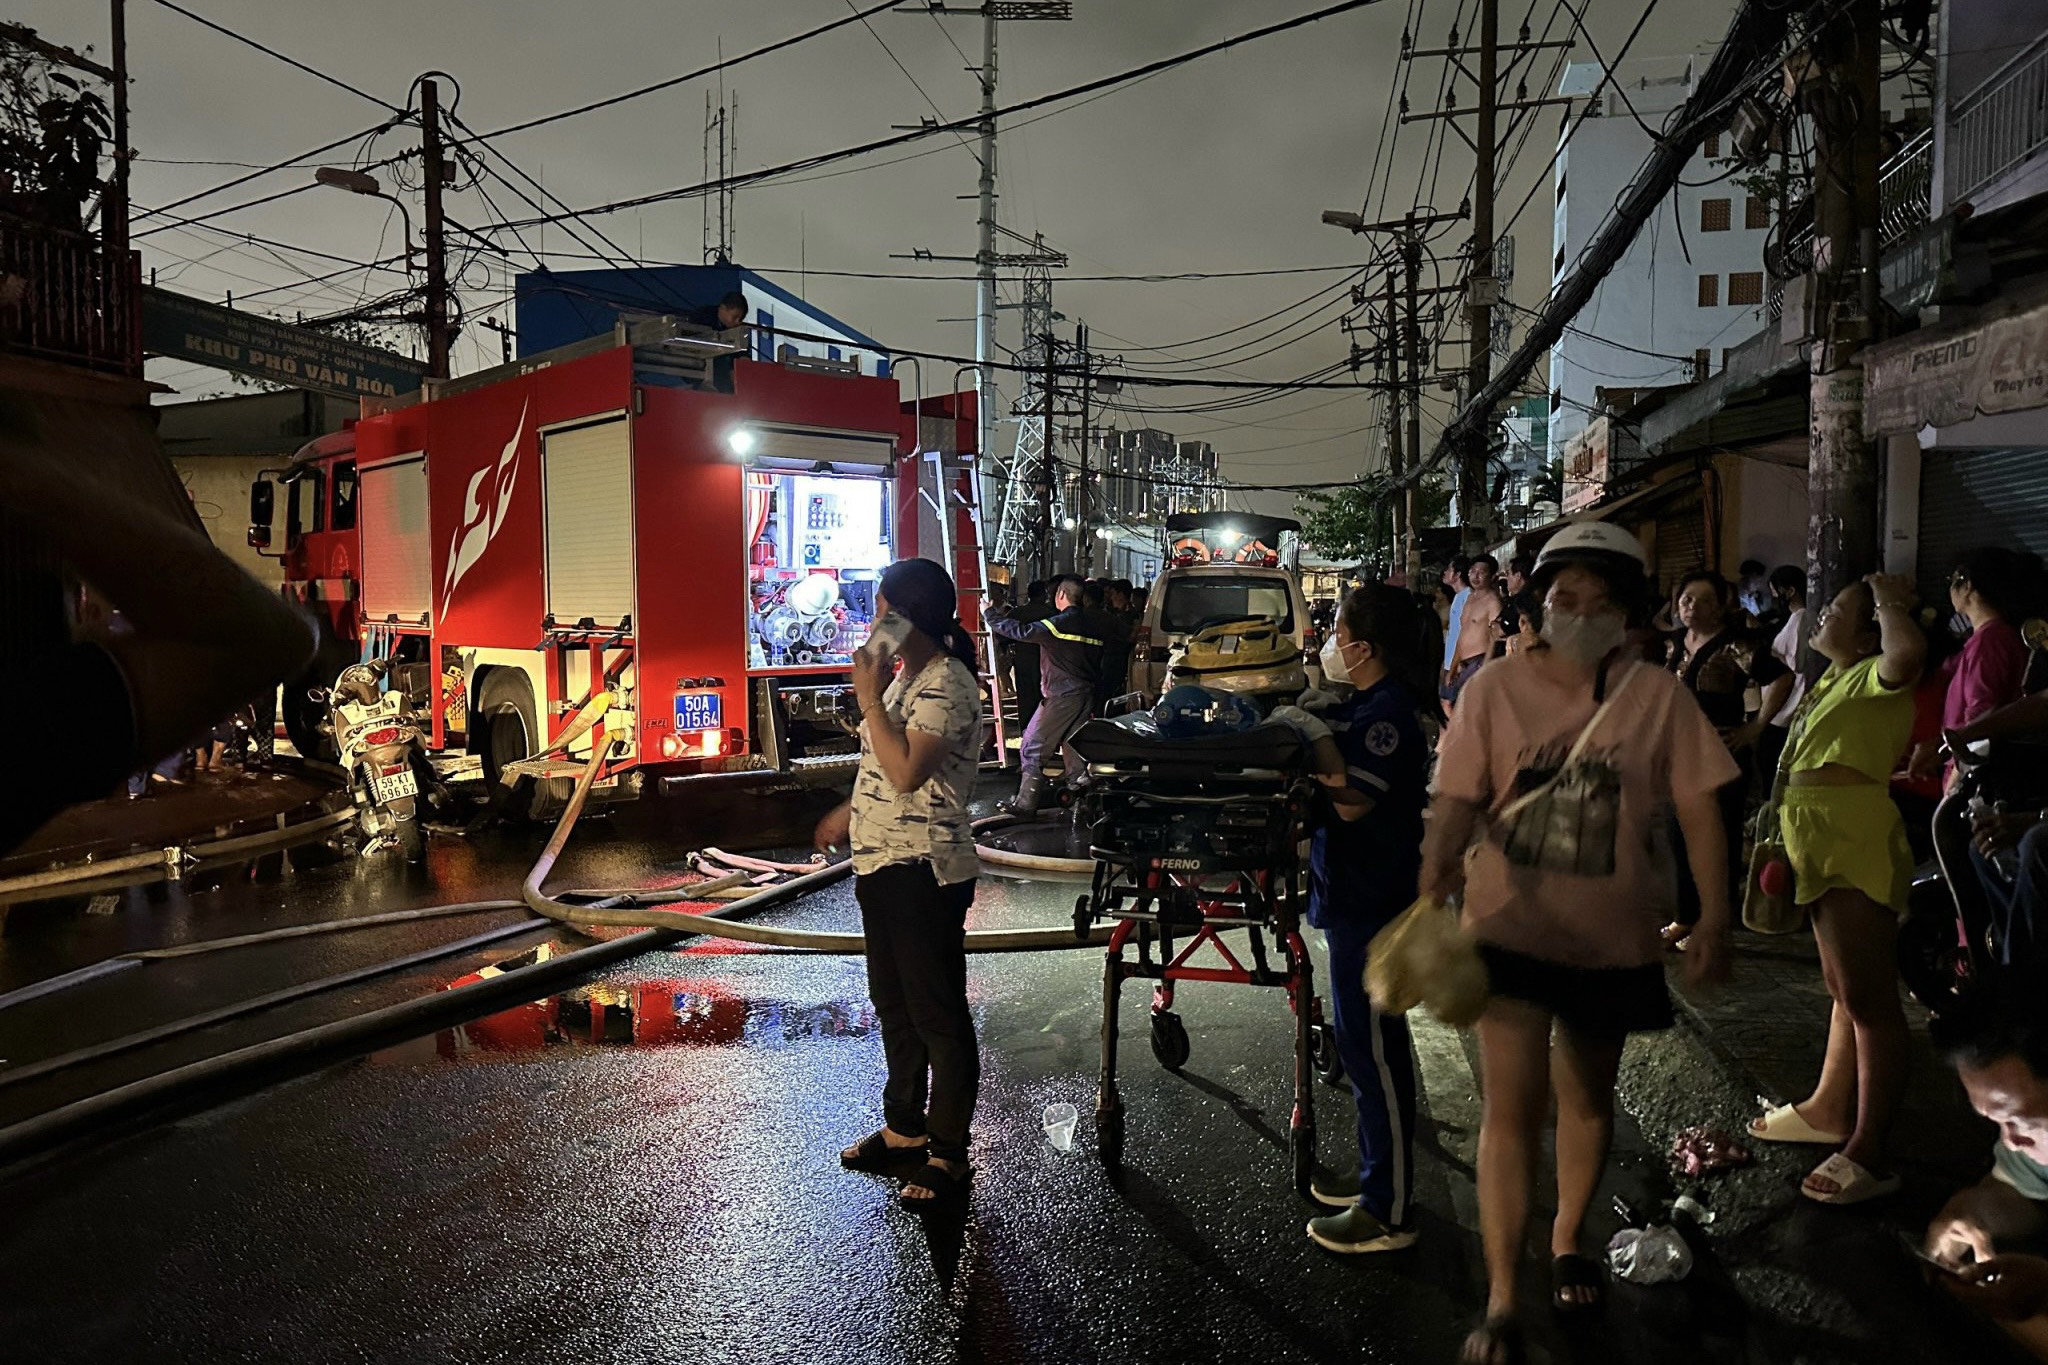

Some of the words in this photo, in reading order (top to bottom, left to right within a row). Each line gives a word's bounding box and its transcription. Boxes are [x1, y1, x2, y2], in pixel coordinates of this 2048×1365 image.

[184, 333, 240, 360] KHU
[249, 349, 297, 374] PHỐ
[304, 363, 348, 387] VĂN
[356, 376, 396, 398] HÓA
[685, 696, 709, 711] 50A
[677, 711, 718, 728] 015.64
[381, 773, 409, 789] 59-K1
[1160, 858, 1200, 870] FERNO
